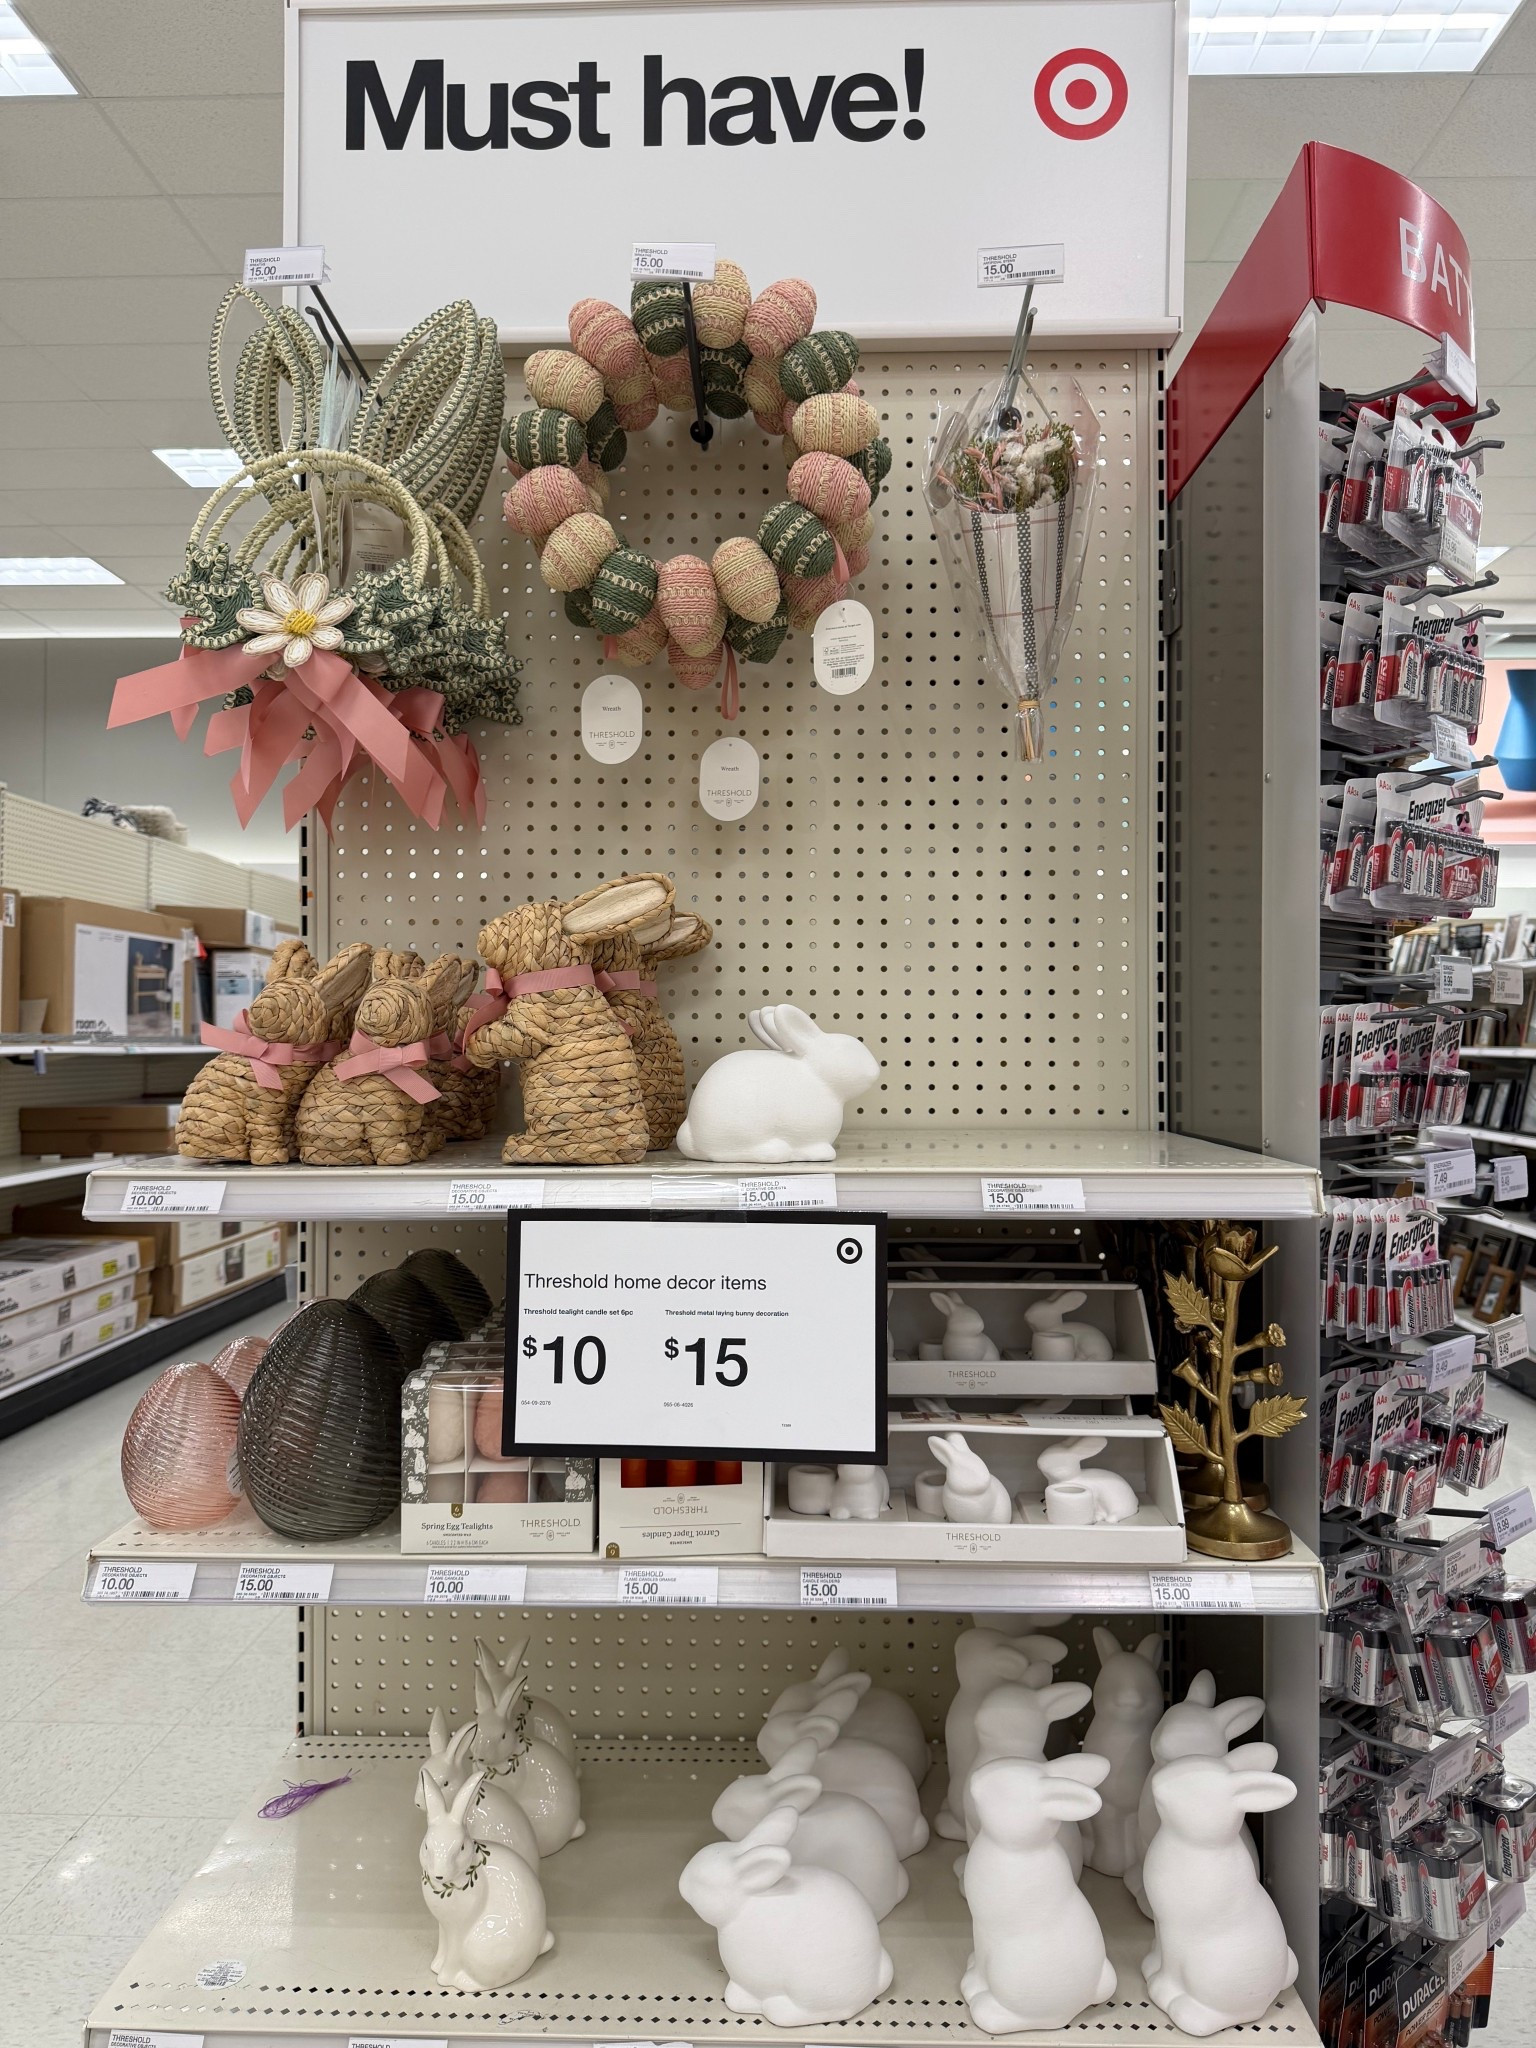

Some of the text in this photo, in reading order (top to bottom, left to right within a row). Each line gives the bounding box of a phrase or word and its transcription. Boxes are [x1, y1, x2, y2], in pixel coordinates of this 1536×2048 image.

[346, 48, 926, 151] Must have!
[250, 266, 276, 276] 15.00
[635, 257, 663, 268] 15.00
[984, 263, 1013, 275] 15.00
[1412, 616, 1454, 640] Energizer
[1404, 657, 1414, 691] Energizer
[1324, 672, 1335, 706] Energizer
[1362, 666, 1373, 700] Energizer
[1450, 679, 1460, 712] Energizer
[1466, 684, 1475, 716] Energizer
[589, 730, 635, 739] THRESHOLD
[707, 789, 752, 797] THRESHOLD
[1408, 797, 1447, 822] Energizer
[1350, 848, 1363, 883] Energizer
[1391, 843, 1401, 878] Energizer
[1403, 855, 1414, 890] Energizer
[1424, 859, 1436, 894] Energizer
[1354, 1020, 1399, 1057] Energizer
[1362, 1050, 1374, 1062] MAX
[1434, 1172, 1447, 1185] 7.49
[131, 1195, 164, 1206] 10.00
[452, 1194, 485, 1204] 15.00
[742, 1191, 775, 1202] 15.00
[989, 1193, 1023, 1203] 15.00
[1390, 1218, 1434, 1260] Energizer
[524, 1273, 766, 1290] Threshold home decor items
[1374, 1395, 1419, 1442] Energizer
[1454, 1448, 1464, 1479] Energizer
[1469, 1451, 1481, 1484] Energizer
[1403, 1482, 1413, 1516] Energizer
[654, 1506, 708, 1514] THRESHOLD
[521, 1519, 580, 1528] THRESHOLD
[1497, 1518, 1509, 1532] 8.99
[946, 1533, 1001, 1542] THRESHOLD
[1447, 1564, 1457, 1578] 8.99
[101, 1578, 134, 1590] 10.00
[240, 1579, 273, 1591] 15.00
[430, 1581, 463, 1593] 10.00
[625, 1582, 658, 1594] 15.00
[804, 1584, 837, 1596] 15.00
[1155, 1588, 1190, 1600] 15.00
[1497, 1626, 1512, 1668] Energizer
[1352, 1652, 1364, 1696] Energizer
[1478, 1662, 1495, 1706] Energizer
[1502, 1836, 1512, 1877] Energizer
[1423, 1880, 1433, 1928] Energizer
[112, 2034, 150, 2043] THRESHOLD
